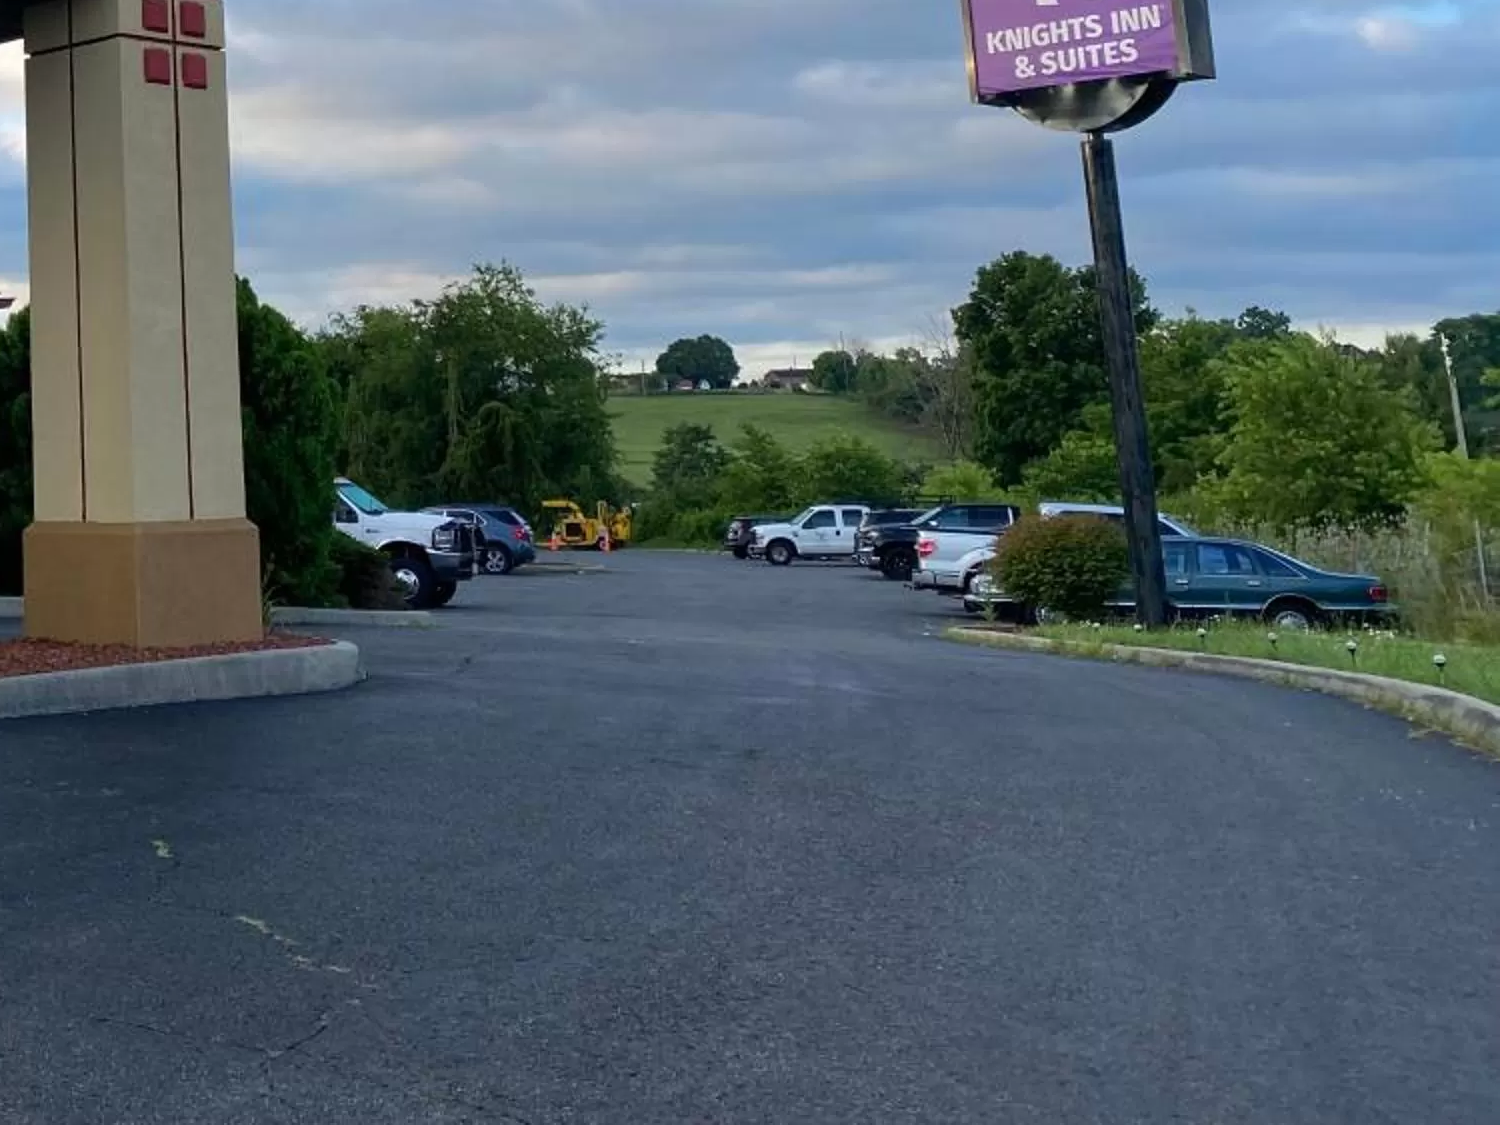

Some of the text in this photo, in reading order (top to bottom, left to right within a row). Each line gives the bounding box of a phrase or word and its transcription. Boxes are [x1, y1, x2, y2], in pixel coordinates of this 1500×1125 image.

[986, 4, 1161, 54] KNIGHTS INN
[1015, 38, 1139, 78] & SUITES
